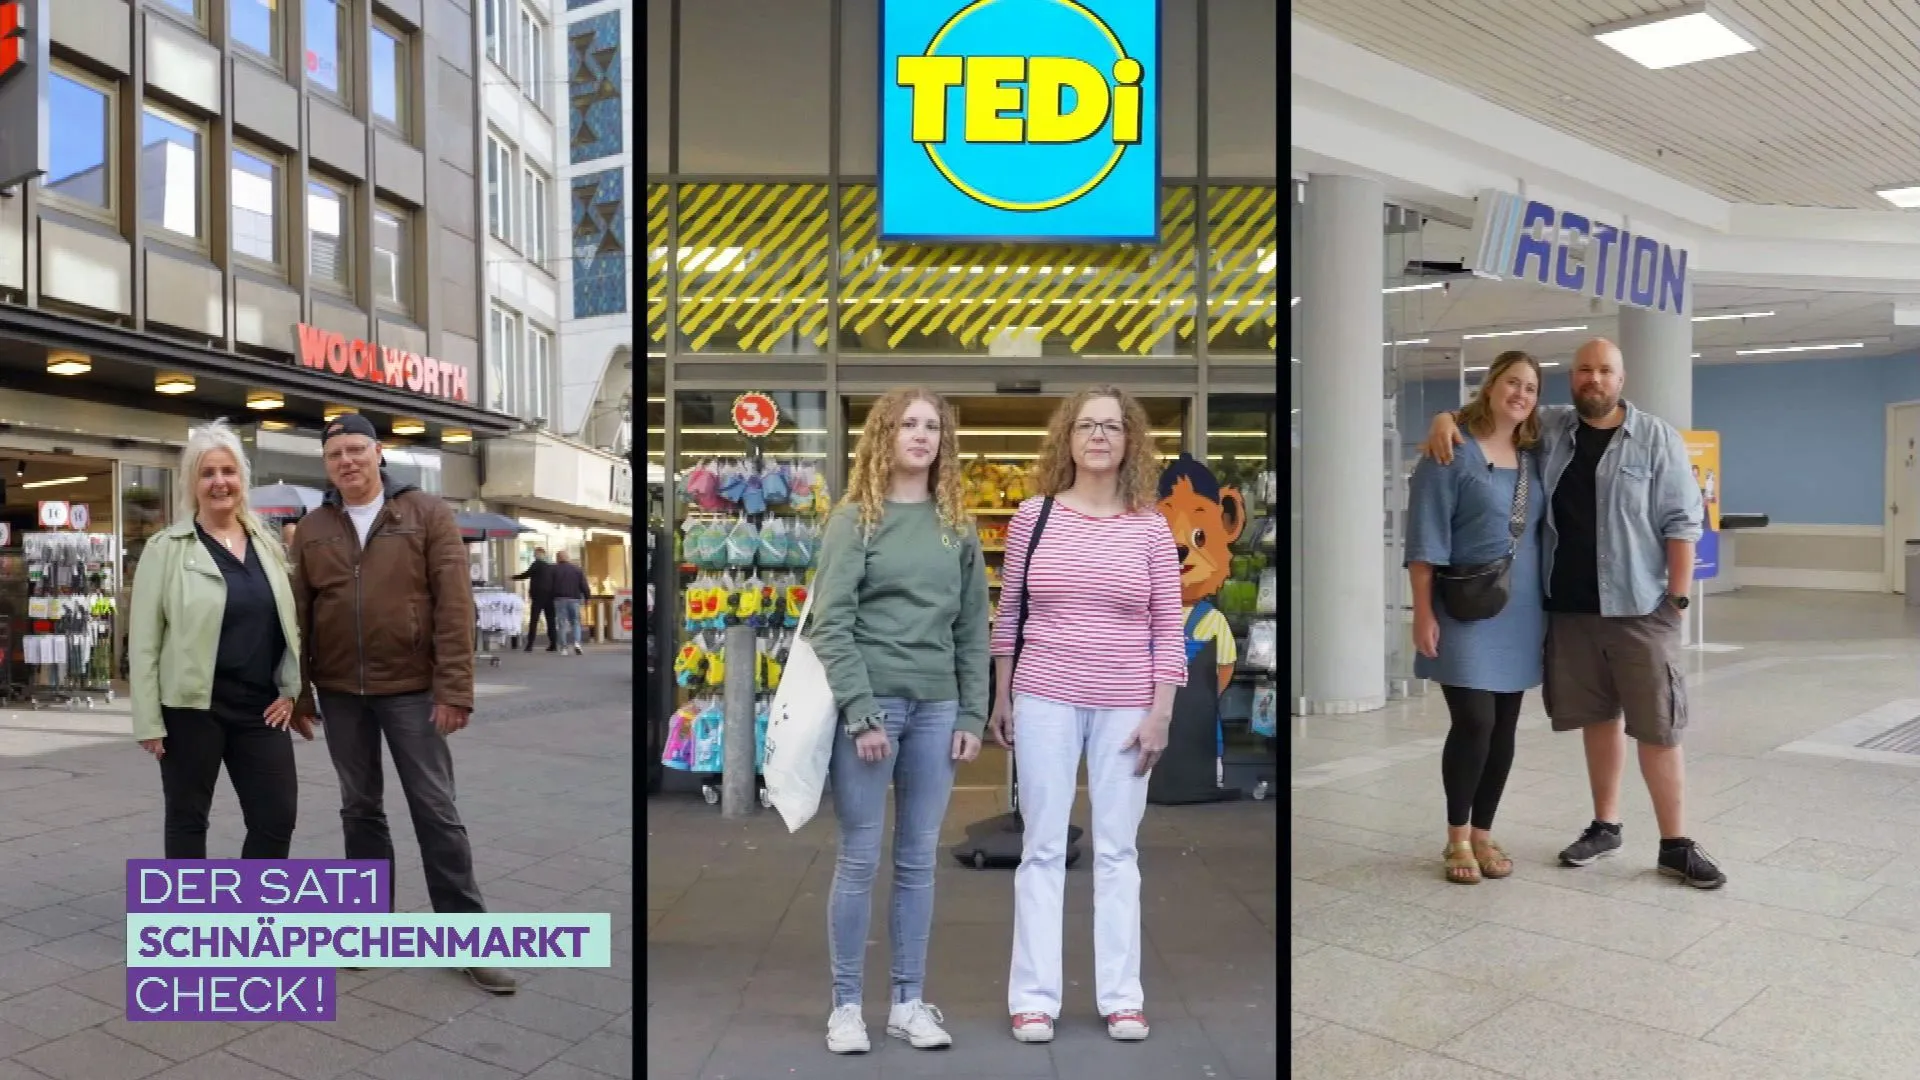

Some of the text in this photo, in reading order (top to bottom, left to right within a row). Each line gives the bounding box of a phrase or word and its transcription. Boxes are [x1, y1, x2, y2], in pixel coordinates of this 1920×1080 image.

[896, 55, 1144, 145] TEDi
[1513, 200, 1687, 316] ACTION
[296, 322, 469, 404] WOOLWORTH
